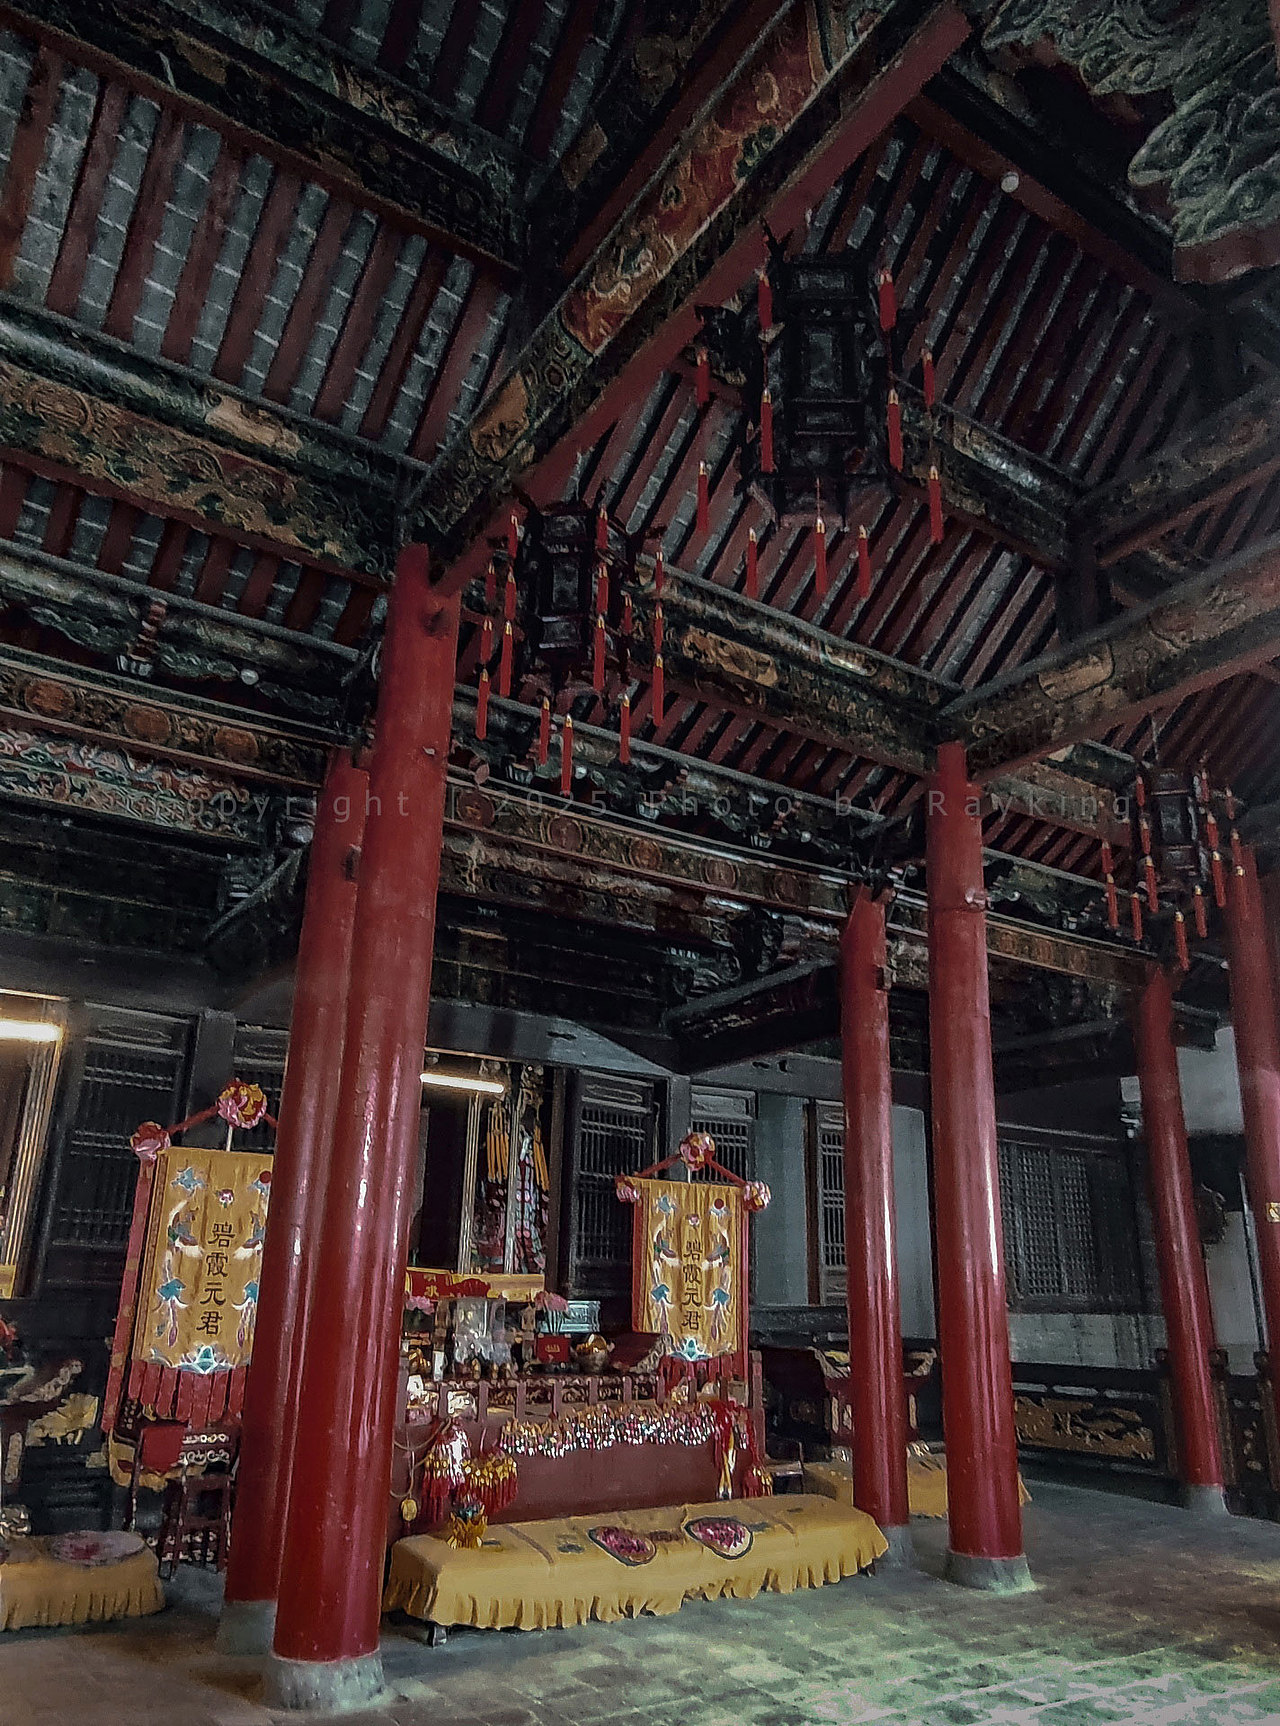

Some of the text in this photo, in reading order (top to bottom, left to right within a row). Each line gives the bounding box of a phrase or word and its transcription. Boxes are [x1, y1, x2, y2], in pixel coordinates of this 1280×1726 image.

[195, 1220, 236, 1335] 碧霞元君
[680, 1239, 703, 1331] 碧霞元君
